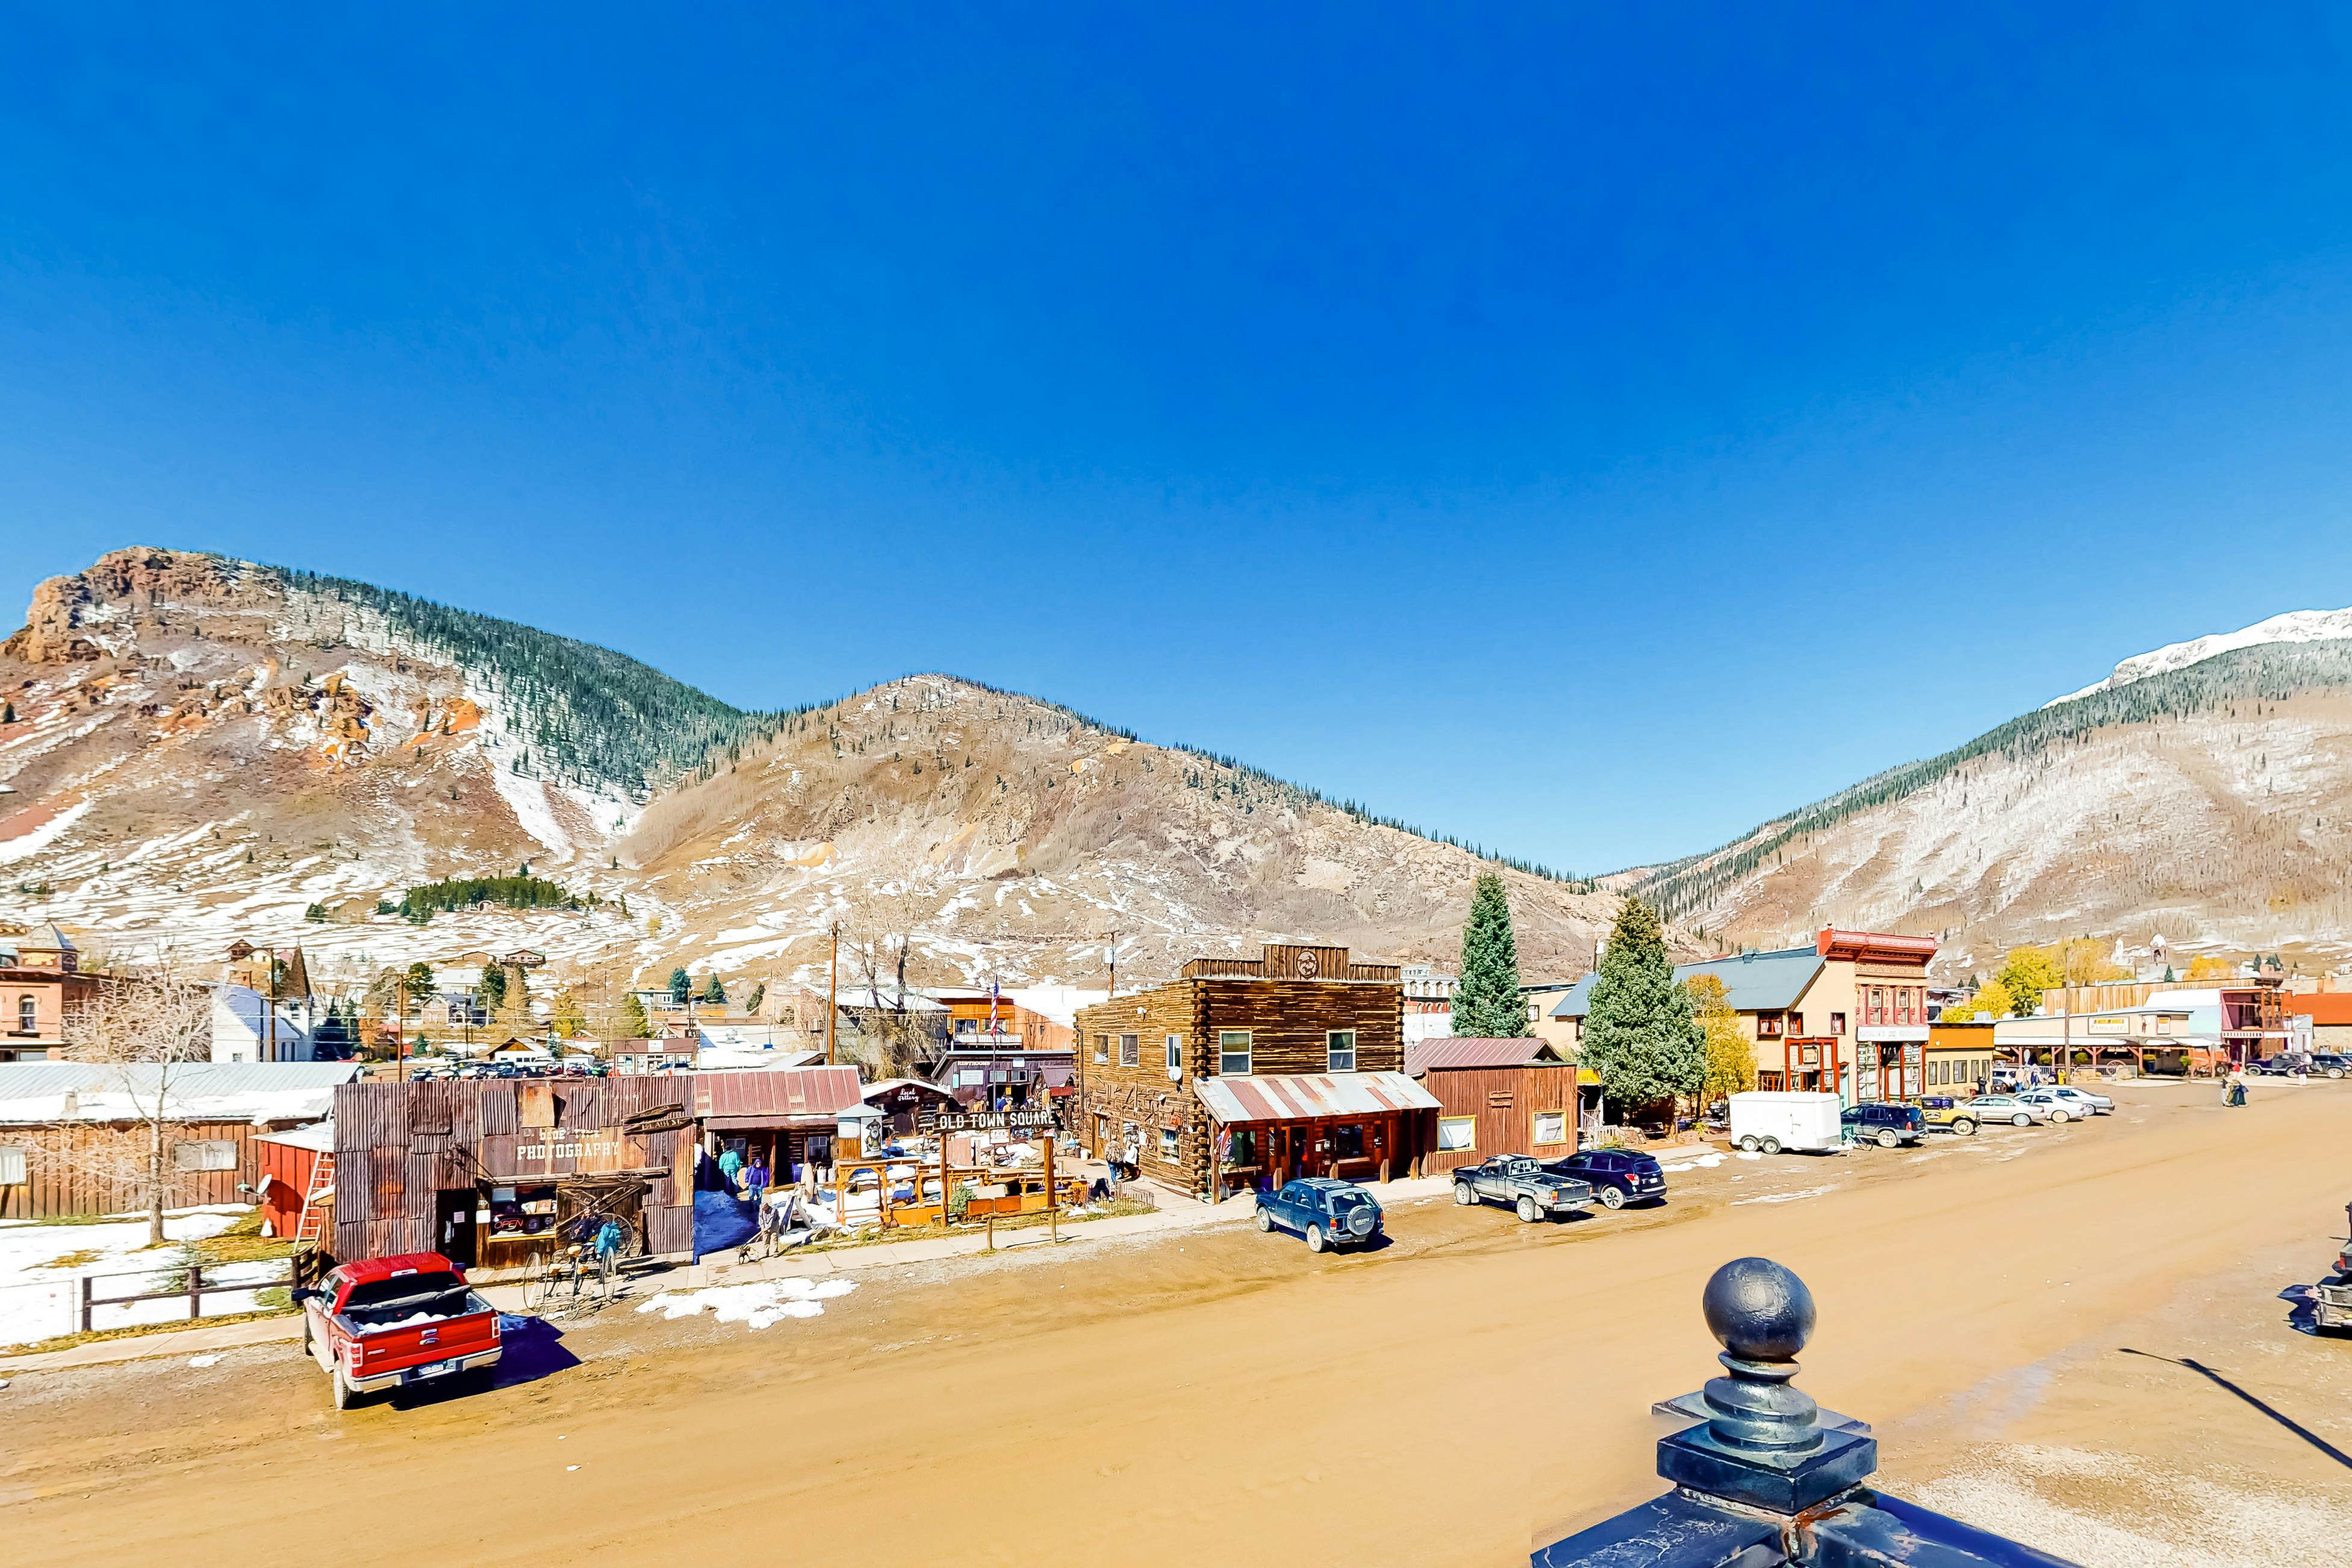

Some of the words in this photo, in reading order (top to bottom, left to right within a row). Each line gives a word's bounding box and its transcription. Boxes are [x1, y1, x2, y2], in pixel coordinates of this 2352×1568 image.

[939, 1115, 964, 1130] OLD
[969, 1113, 1005, 1128] TOWN
[1010, 1111, 1056, 1126] SQUARE
[517, 1142, 620, 1160] PHOTOGRAPHY
[494, 1219, 523, 1228] OPEN
